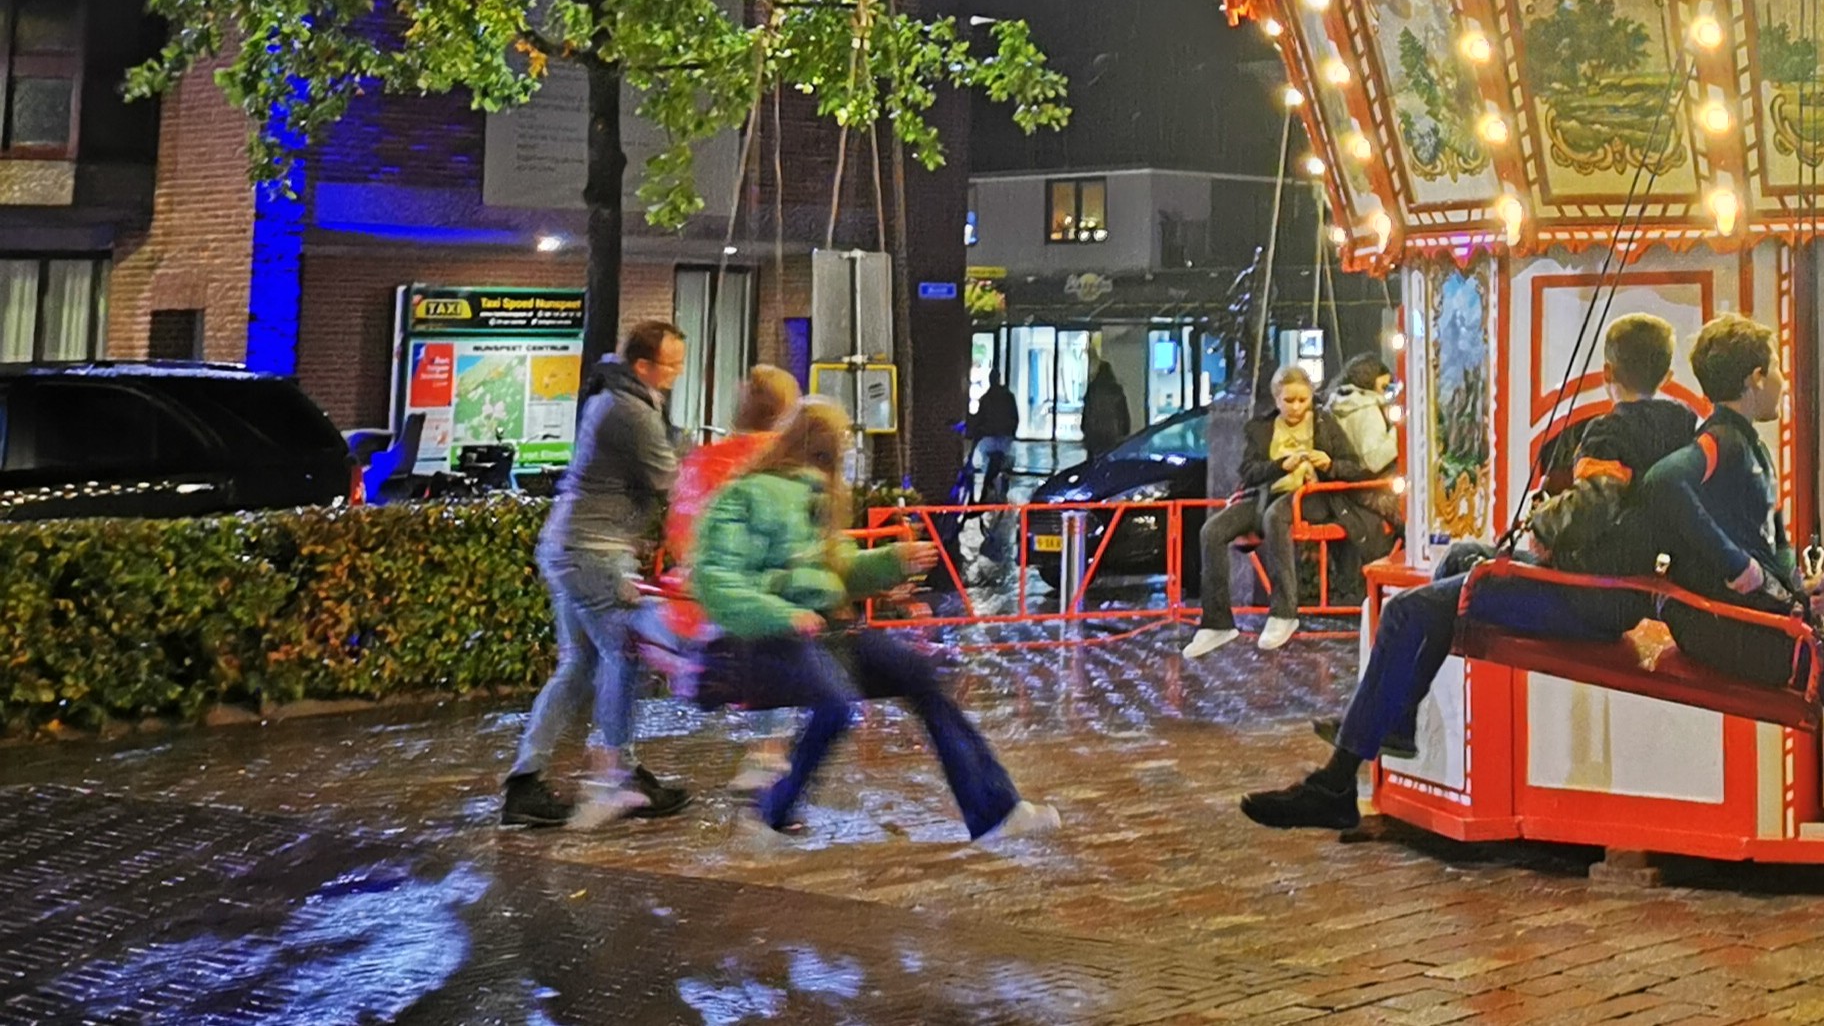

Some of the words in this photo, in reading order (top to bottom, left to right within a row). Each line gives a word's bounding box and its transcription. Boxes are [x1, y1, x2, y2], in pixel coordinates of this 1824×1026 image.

[428, 302, 462, 315] TAXI
[481, 297, 501, 309] Taxi
[535, 298, 582, 311] Nunspeet
